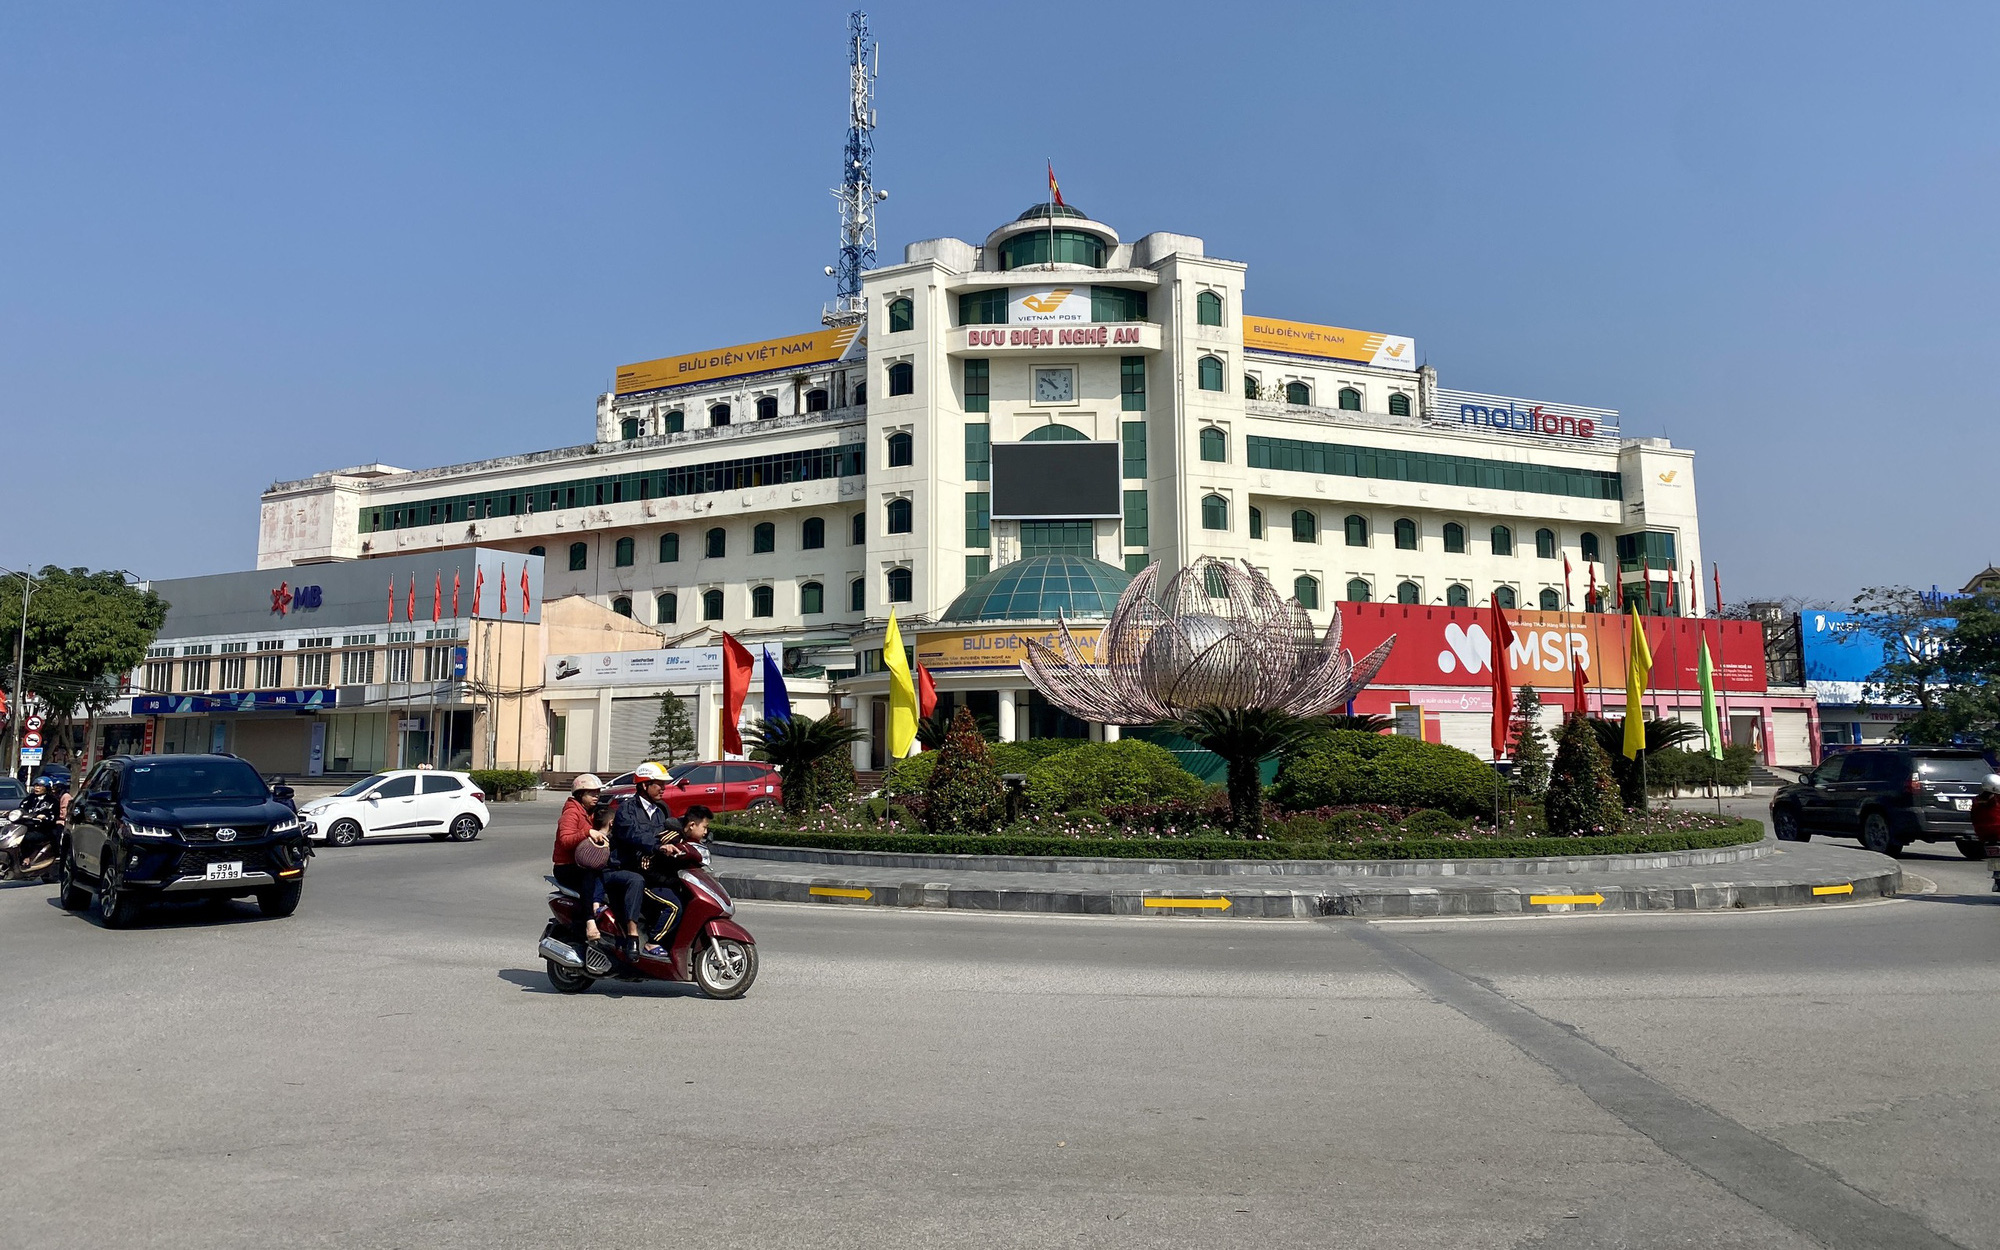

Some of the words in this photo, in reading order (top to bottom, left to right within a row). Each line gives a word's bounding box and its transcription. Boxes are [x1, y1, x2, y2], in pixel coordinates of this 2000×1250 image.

[968, 328, 1006, 346] BƯU
[1010, 327, 1053, 348] ĐIỆN
[1058, 326, 1107, 347] NGHỆ
[1113, 327, 1140, 345] AN
[1253, 325, 1275, 335] BƯU
[1276, 327, 1300, 338] ĐIỆN
[1301, 330, 1321, 341] VIỆT
[1323, 334, 1345, 344] NAM
[678, 358, 707, 372] BƯU
[709, 352, 743, 366] ĐIỆN
[746, 345, 778, 361] VIỆT
[781, 341, 813, 355] NAM
[1461, 402, 1595, 438] mobifone
[293, 585, 322, 610] MB
[1828, 621, 1860, 632] VNPT
[963, 635, 992, 650] BƯU
[1511, 630, 1590, 672] MSB
[666, 656, 679, 664] EMS
[149, 701, 159, 709] MB
[210, 698, 220, 707] MB
[275, 696, 286, 704] MB
[1871, 711, 1894, 721] TRUNG
[217, 863, 232, 871] 99A
[210, 870, 239, 880] 573.99
